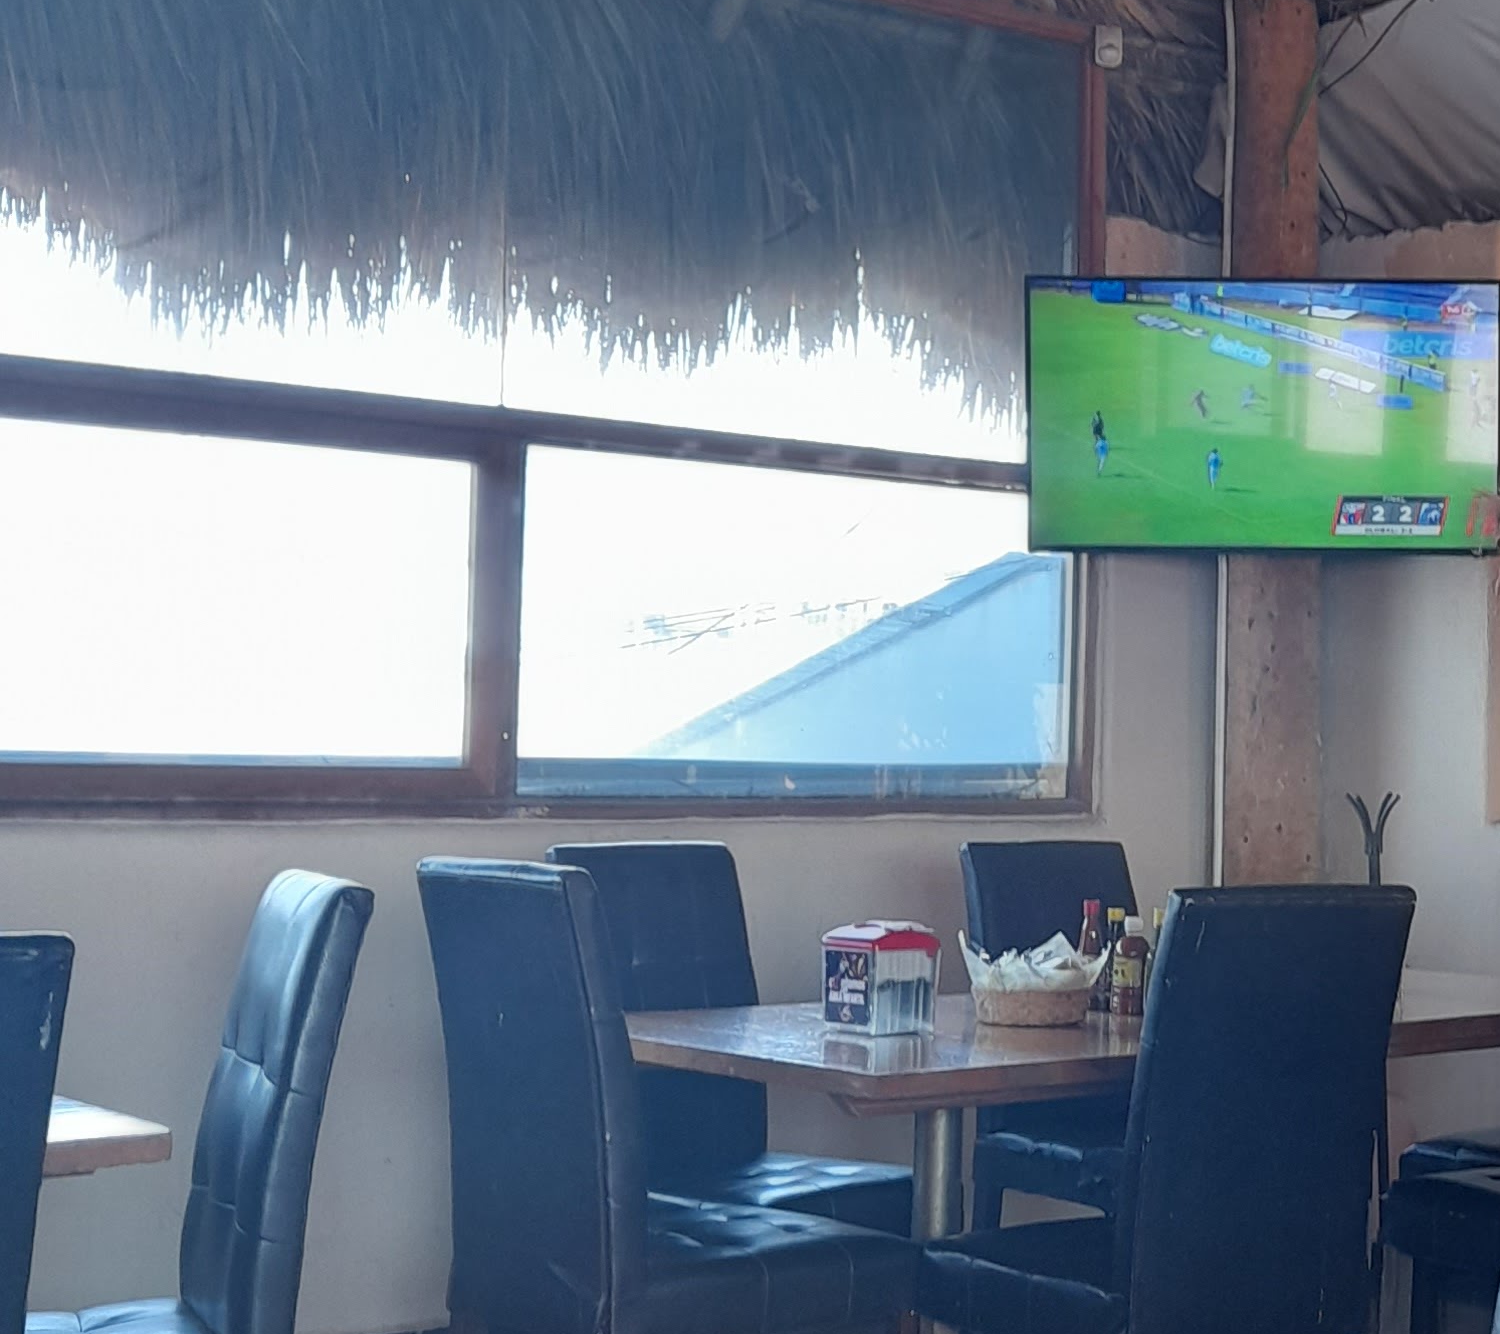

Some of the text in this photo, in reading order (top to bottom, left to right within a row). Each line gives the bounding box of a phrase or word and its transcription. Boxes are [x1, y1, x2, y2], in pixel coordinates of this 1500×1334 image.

[1210, 333, 1272, 367] betcris
[1383, 334, 1473, 357] betcris
[1371, 505, 1412, 522] 2 2
